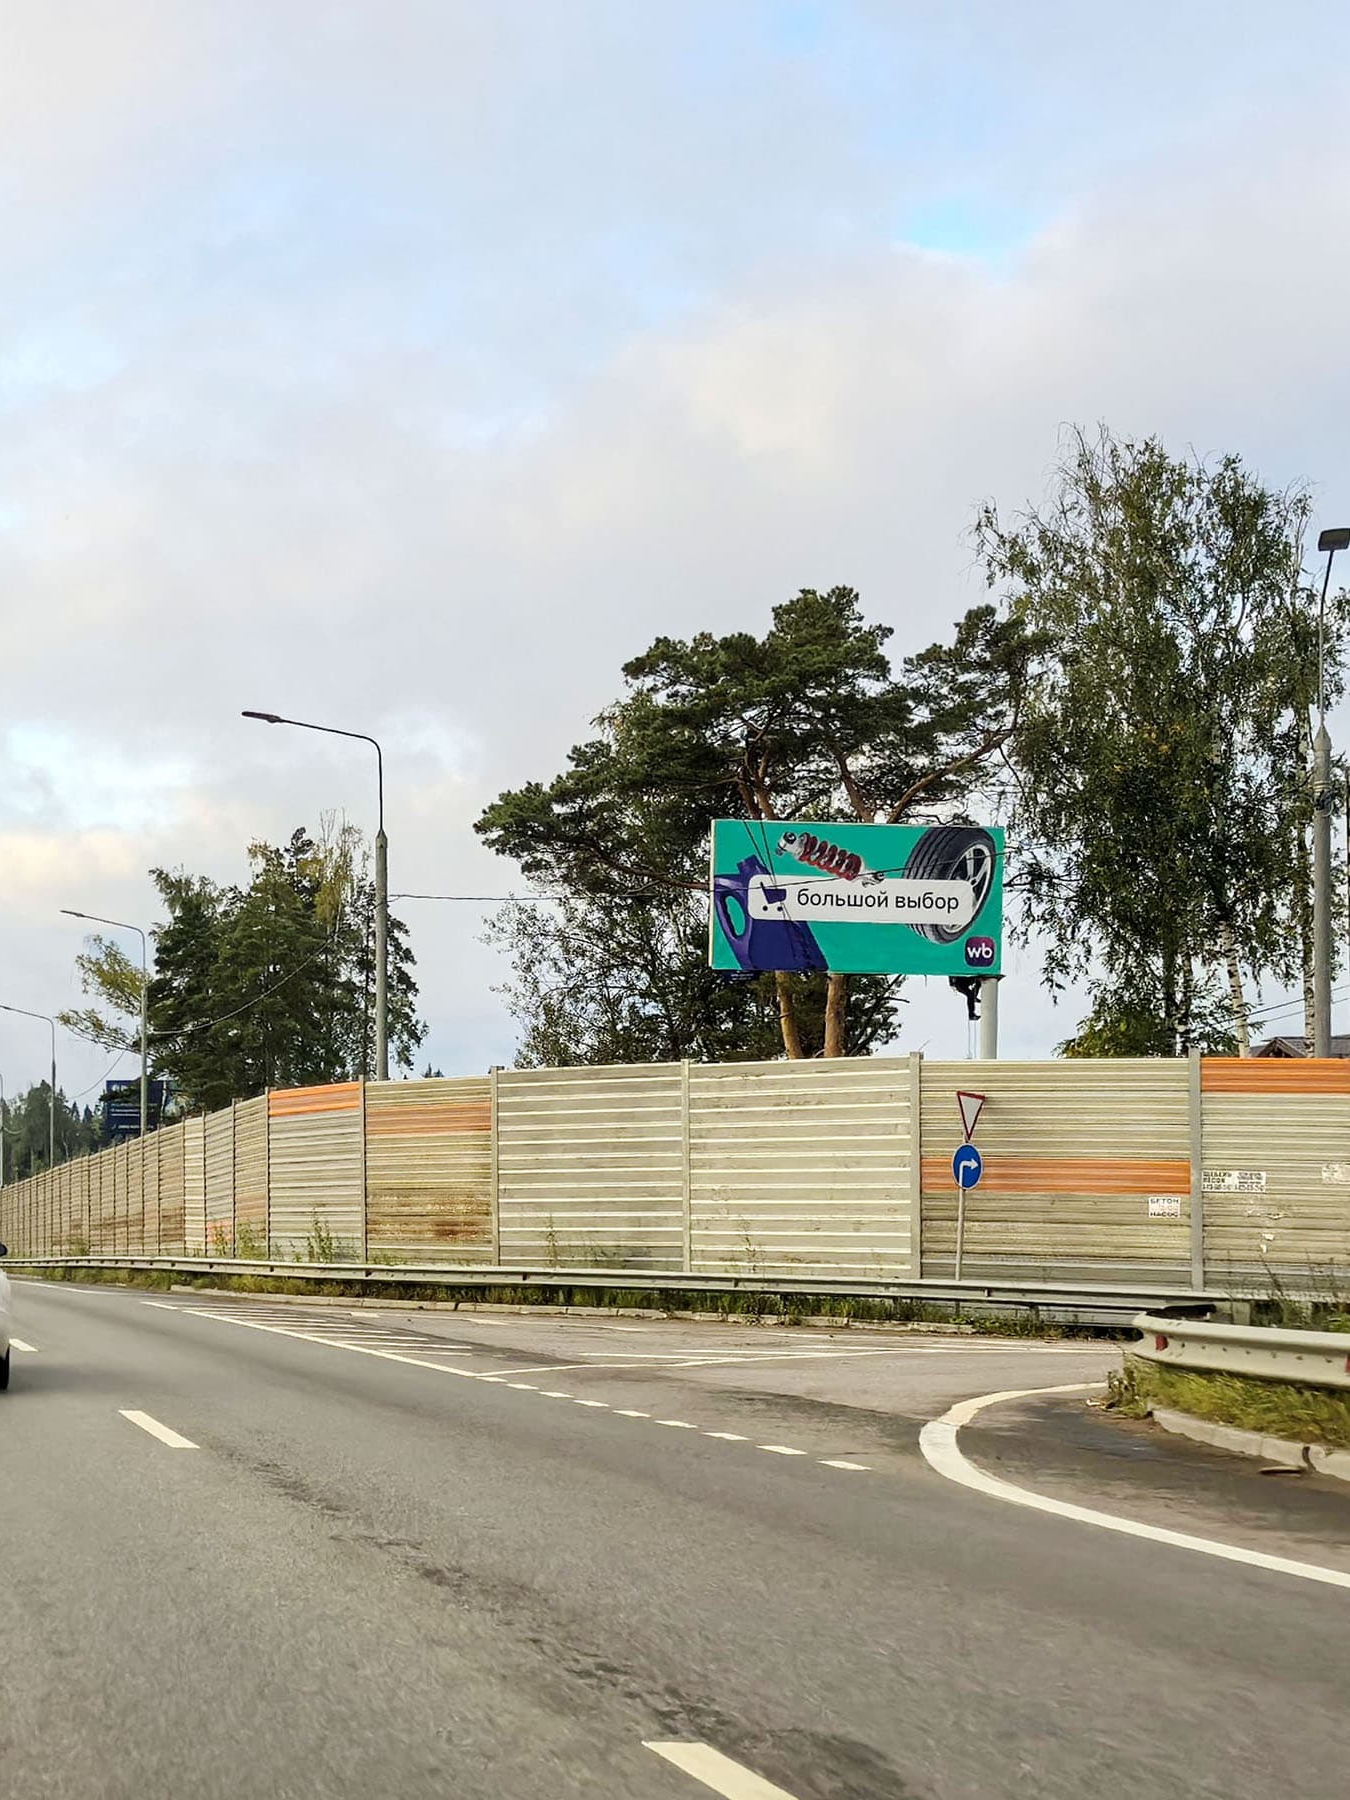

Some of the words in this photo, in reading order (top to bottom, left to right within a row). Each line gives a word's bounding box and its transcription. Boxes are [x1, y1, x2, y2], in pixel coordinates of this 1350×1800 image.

[797, 888, 889, 908] большой
[895, 891, 960, 914] выбор
[967, 943, 993, 959] wb
